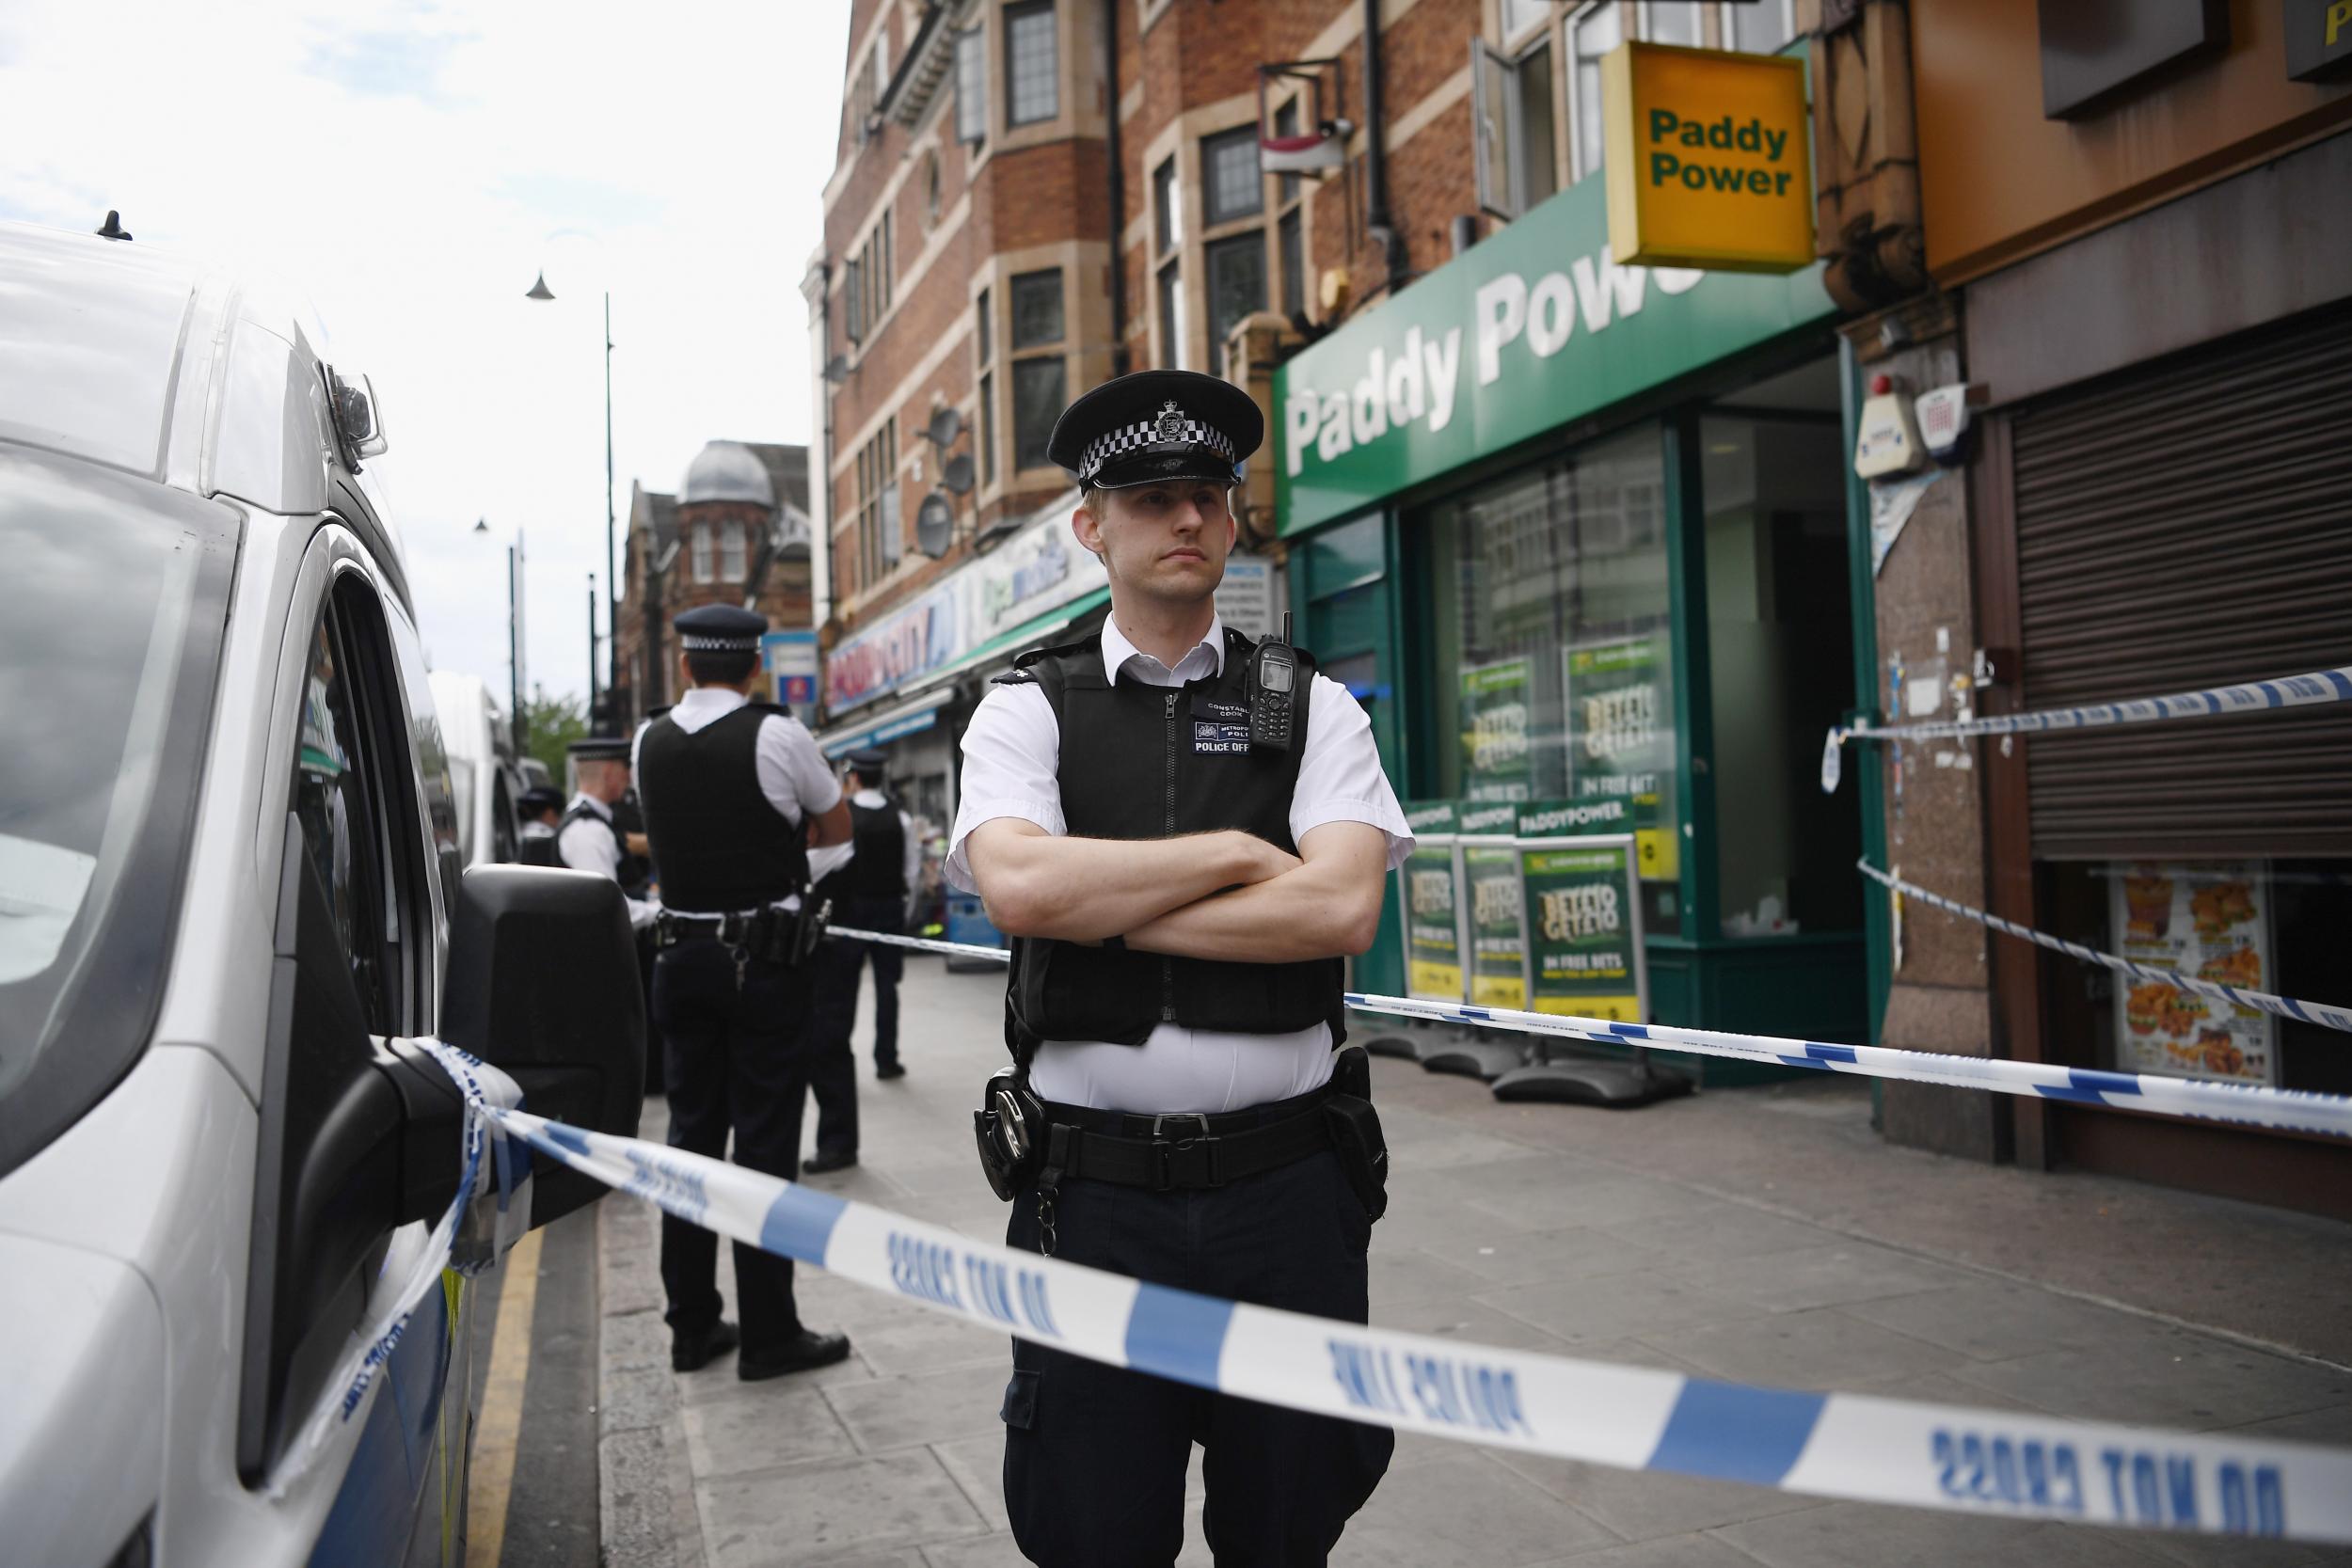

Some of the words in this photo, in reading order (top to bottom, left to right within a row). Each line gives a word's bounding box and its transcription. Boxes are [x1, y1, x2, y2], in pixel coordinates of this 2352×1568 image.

[1650, 108, 1787, 162] Paddy
[1651, 152, 1791, 197] Power
[1285, 325, 1462, 477] Paddy
[1476, 243, 1705, 388] Pow
[1208, 703, 1250, 714] CONSTABL
[1195, 742, 1230, 752] POLICE
[1232, 742, 1249, 752] OFF
[1629, 772, 1655, 793] BET
[1561, 954, 1588, 970] FREE
[1591, 953, 1623, 970] BETS
